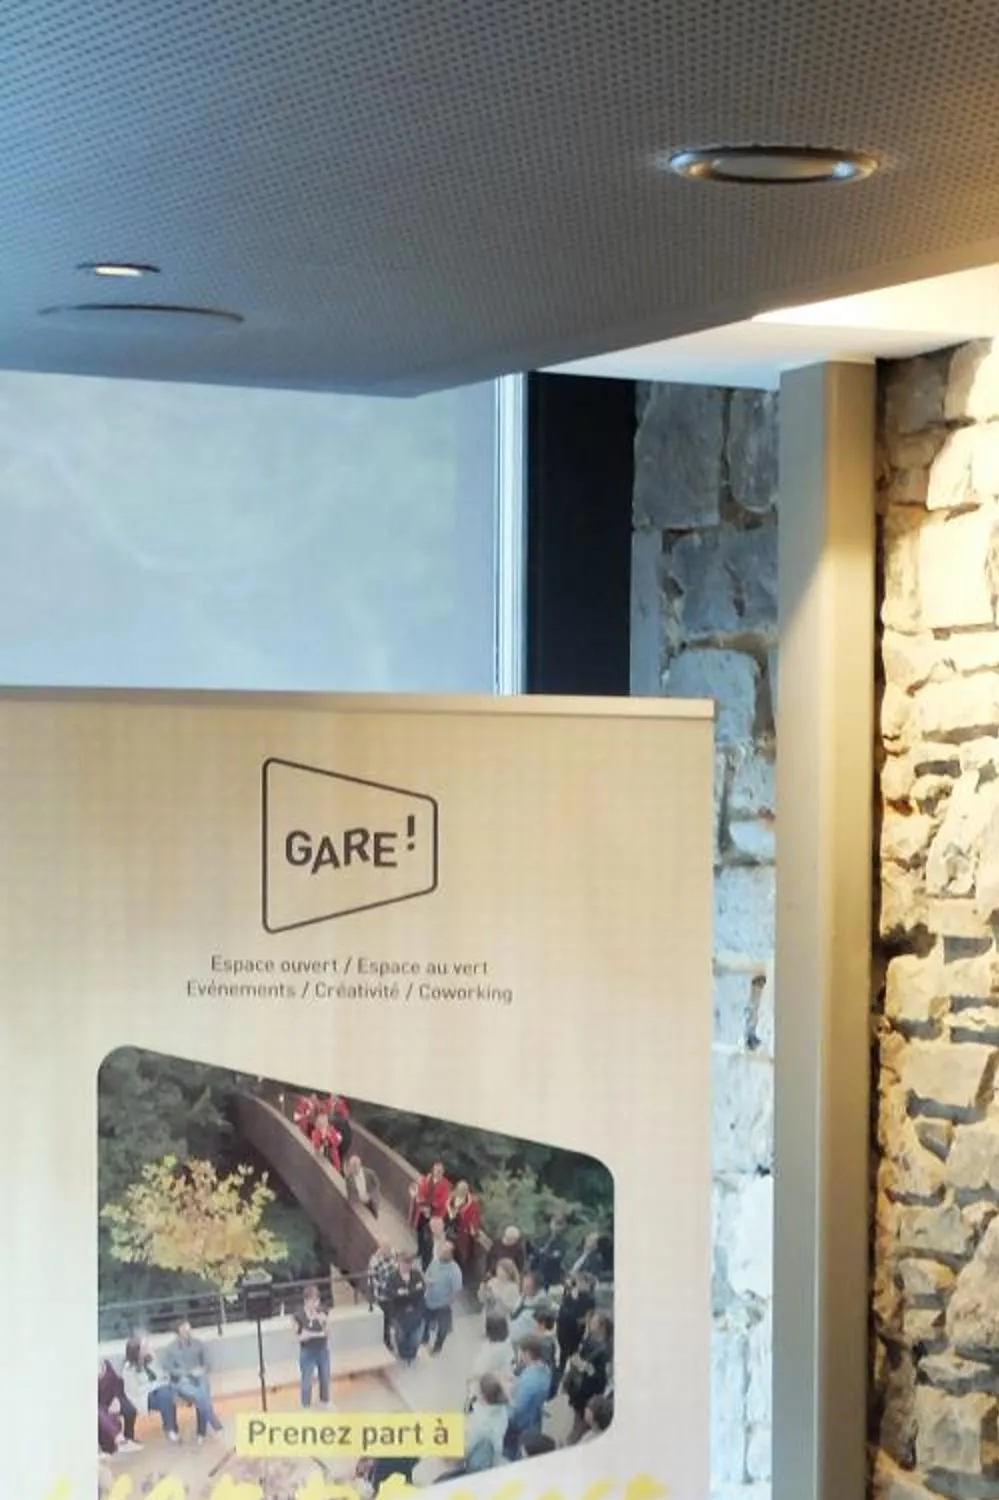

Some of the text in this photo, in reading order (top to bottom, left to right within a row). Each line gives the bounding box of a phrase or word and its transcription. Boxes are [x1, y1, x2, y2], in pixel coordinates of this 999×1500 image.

[285, 814, 416, 874] GARE!
[211, 954, 489, 977] Espace ouvert / Espace au vert
[301, 981, 310, 1000] /
[315, 980, 400, 999] Créativité
[405, 982, 414, 1002] /
[419, 982, 514, 1006] Coworking
[248, 1417, 449, 1451] Prenez part à
